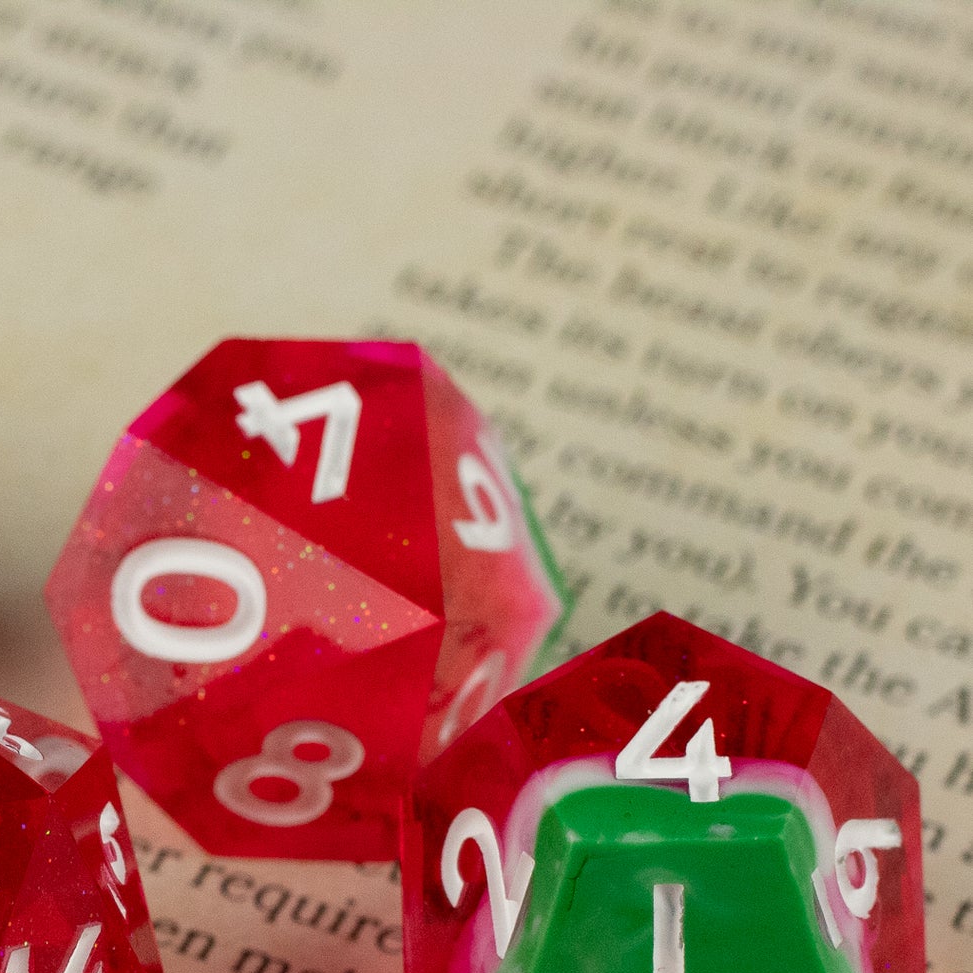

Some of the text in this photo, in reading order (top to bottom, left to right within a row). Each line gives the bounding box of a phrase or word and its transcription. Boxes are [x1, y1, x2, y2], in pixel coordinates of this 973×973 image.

[233, 380, 362, 504] 4
[111, 537, 267, 663] 0
[214, 719, 365, 827] 8
[615, 681, 733, 803] 4
[441, 807, 535, 960] 2
